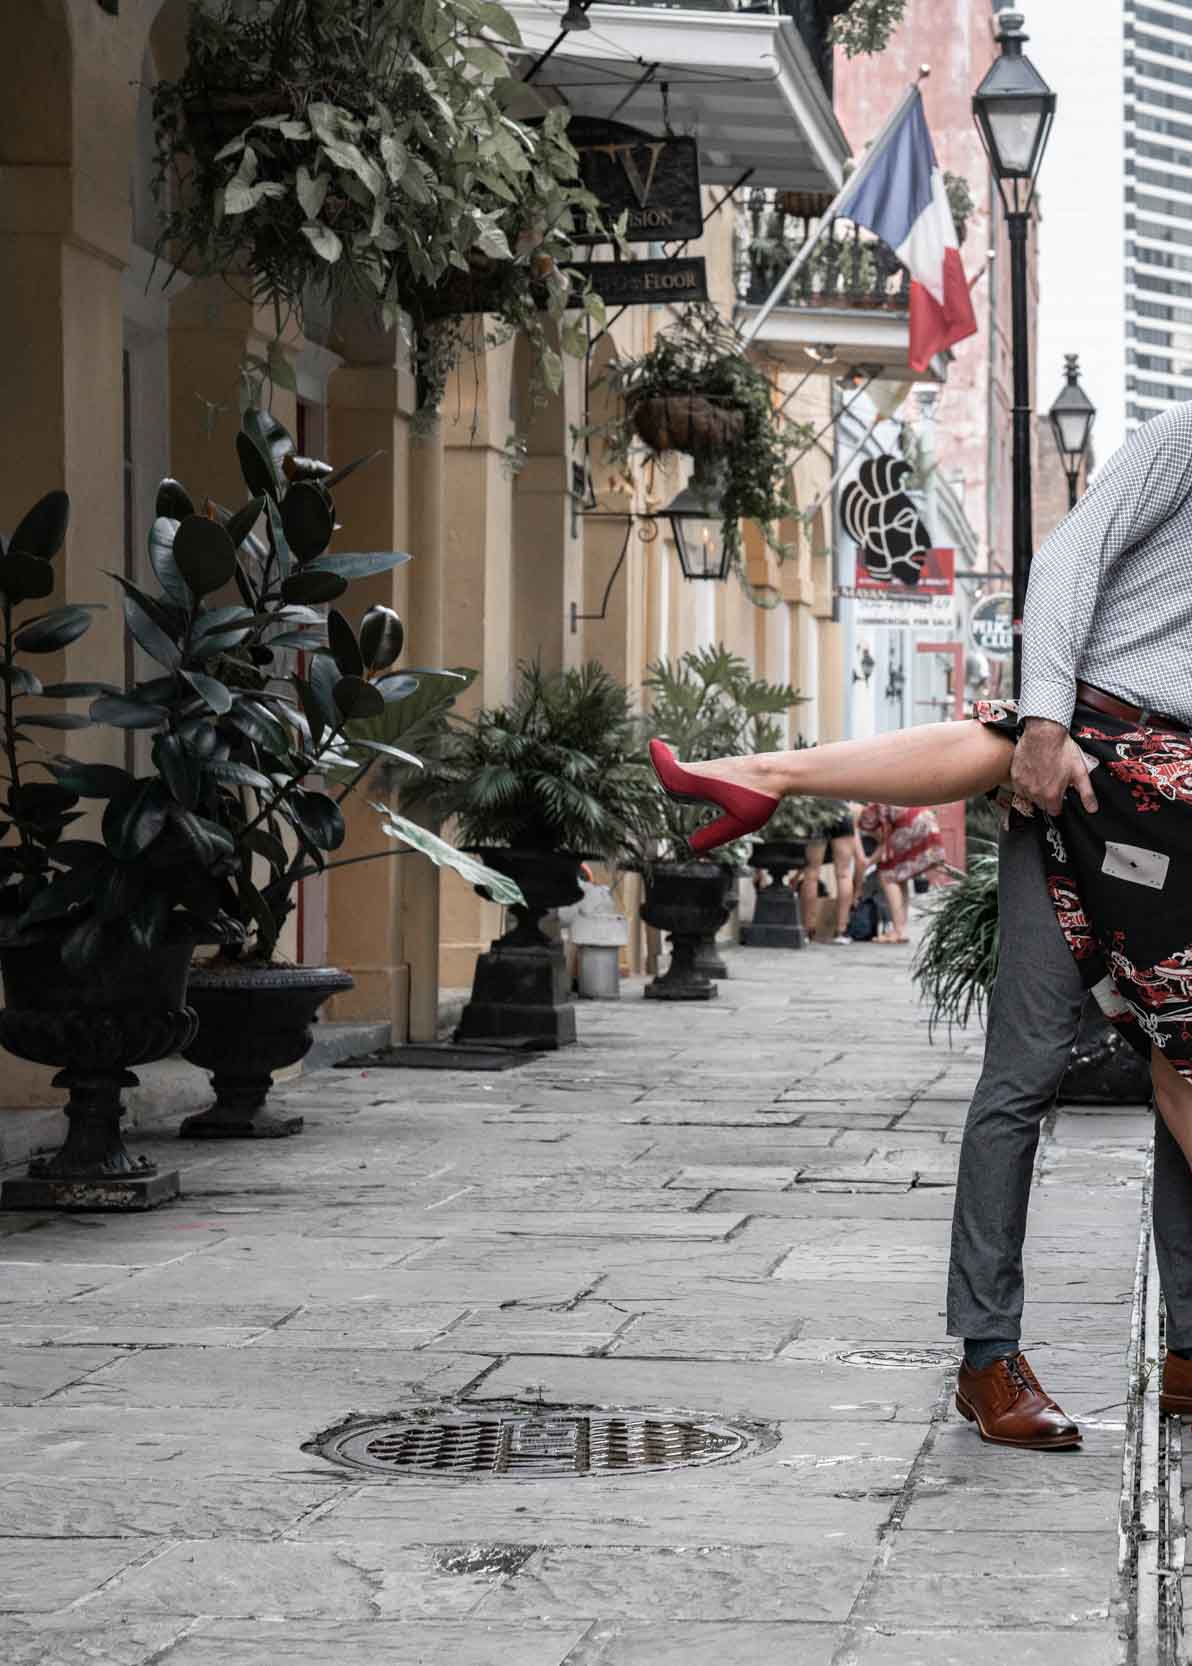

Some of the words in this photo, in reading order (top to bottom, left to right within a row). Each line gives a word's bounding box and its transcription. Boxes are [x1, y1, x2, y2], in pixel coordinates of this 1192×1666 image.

[642, 271, 697, 290] FLOOR
[913, 617, 929, 626] FOR
[980, 633, 1013, 648] CLU
